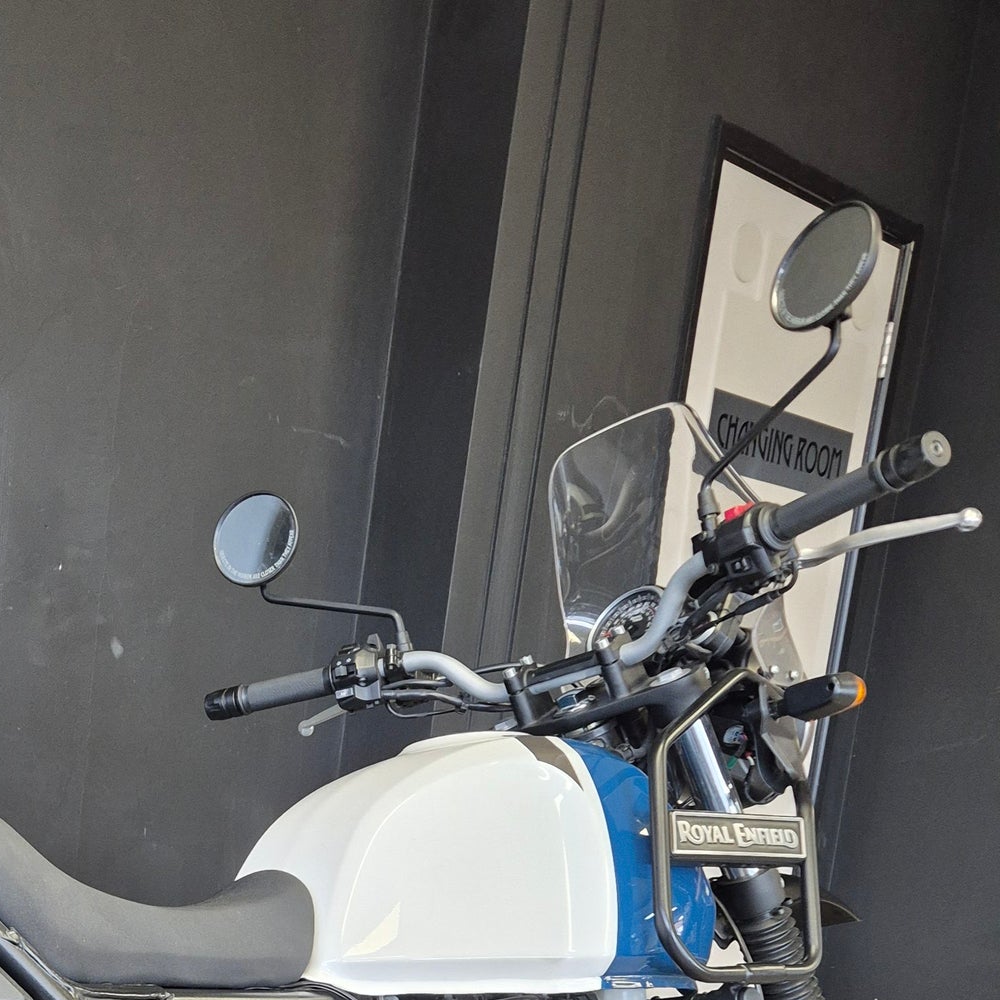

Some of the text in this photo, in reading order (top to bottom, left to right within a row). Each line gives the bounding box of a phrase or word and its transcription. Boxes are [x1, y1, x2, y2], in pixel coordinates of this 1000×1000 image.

[794, 437, 842, 480] ROOM
[676, 820, 800, 849] ROYAL ENFIELD
